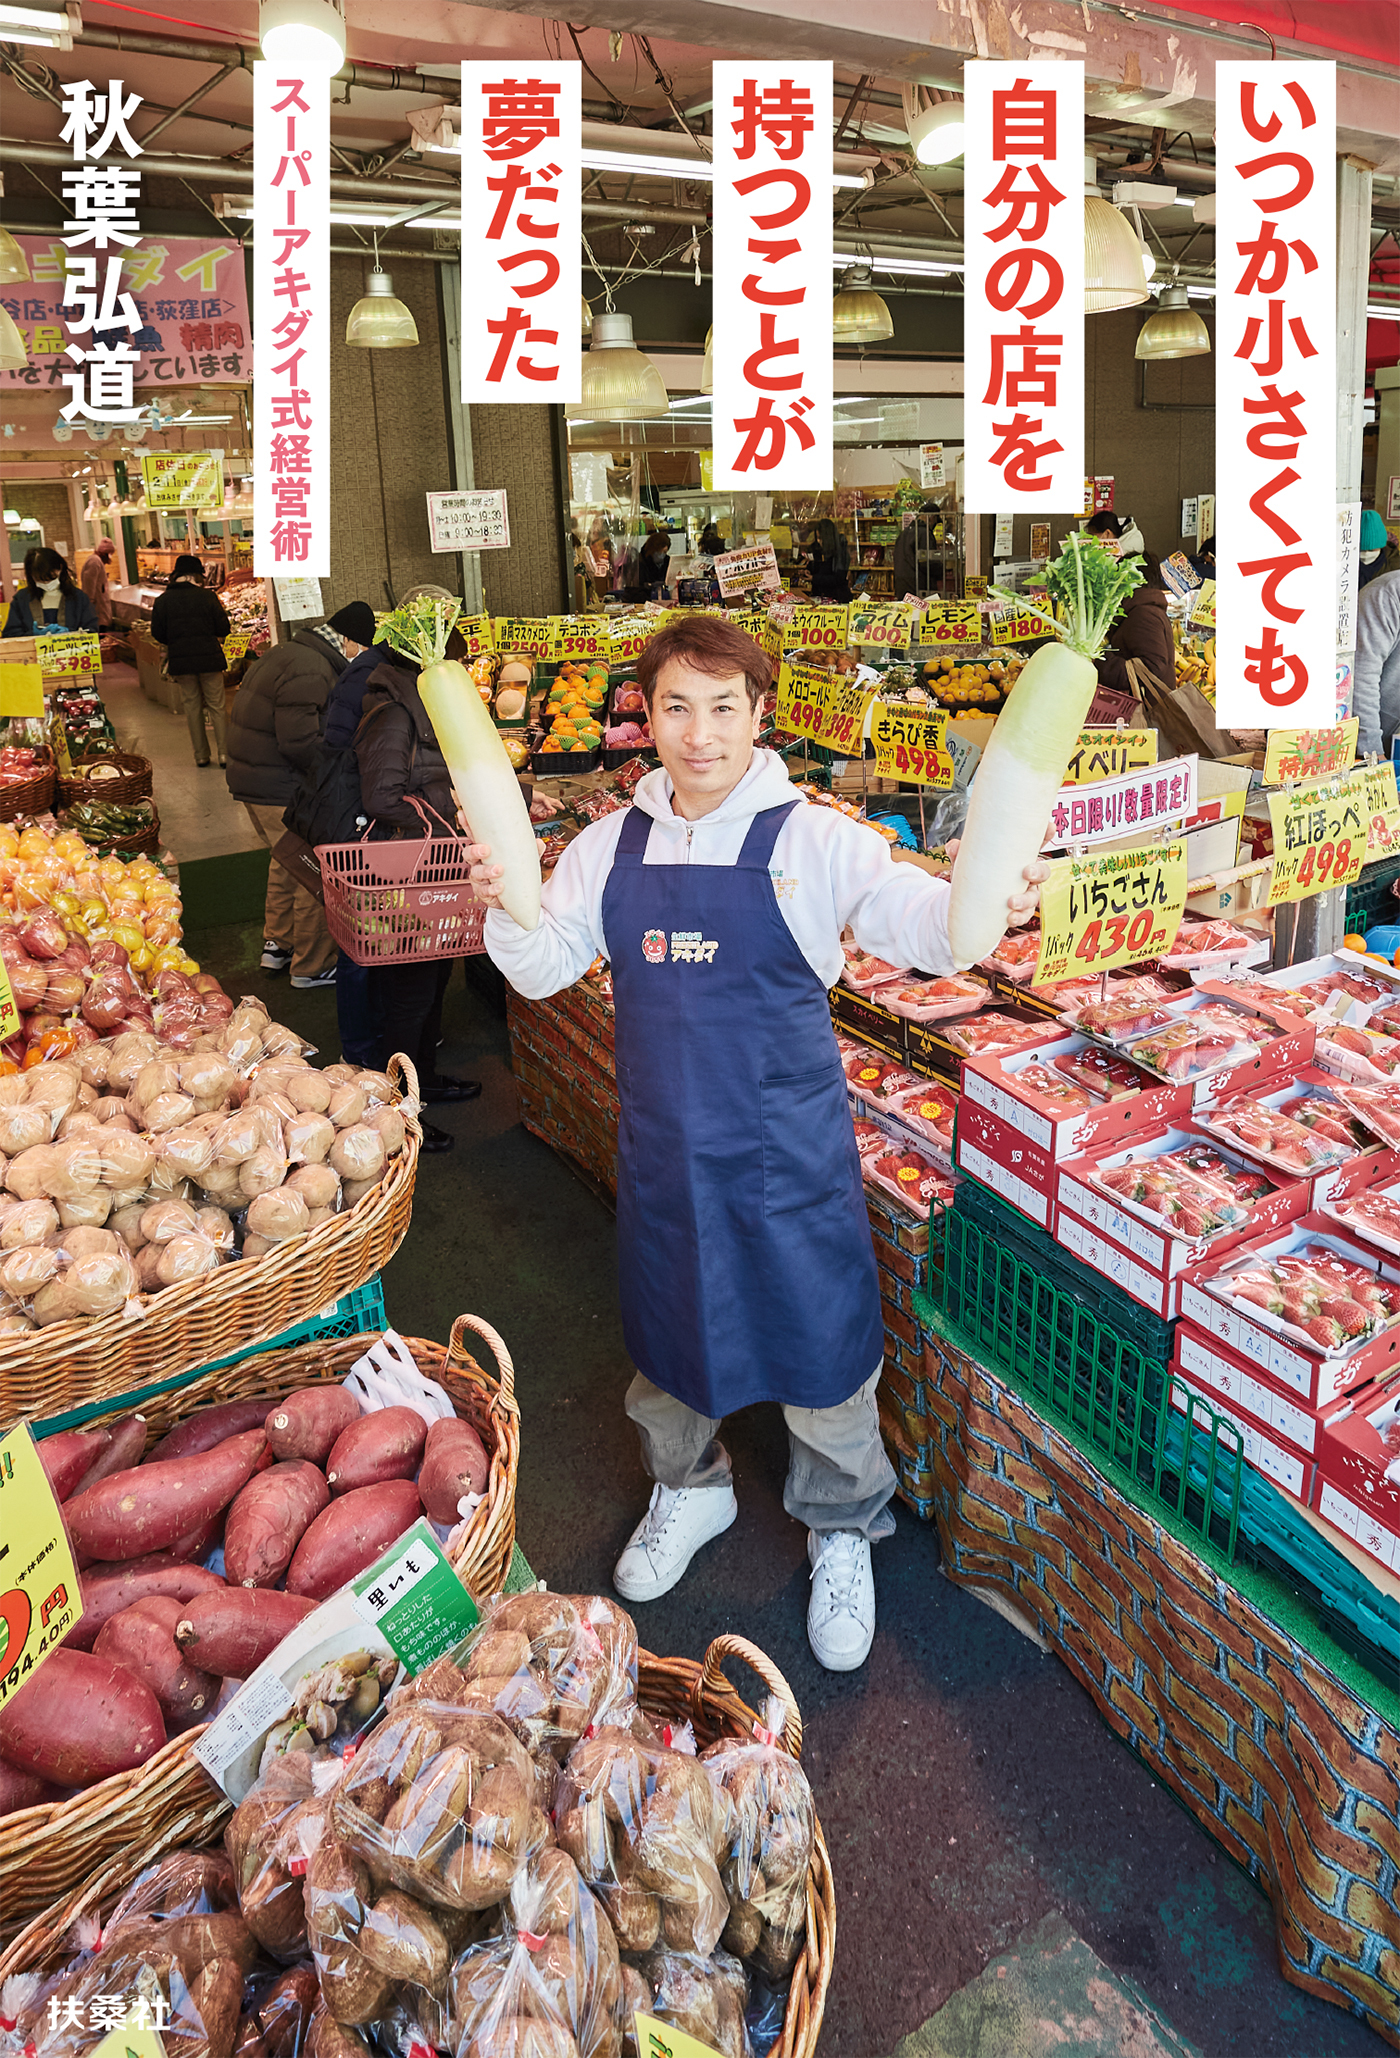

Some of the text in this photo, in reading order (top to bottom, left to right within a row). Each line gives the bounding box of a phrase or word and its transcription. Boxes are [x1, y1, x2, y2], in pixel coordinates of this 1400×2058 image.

[179, 321, 244, 352] 精肉
[792, 614, 842, 628] キウイフルーツ
[861, 609, 908, 628] ライム
[926, 609, 975, 624] レモン
[501, 625, 550, 641] 静岡マスクメロン
[559, 623, 601, 637] デコポン
[801, 628, 843, 645] 100円
[865, 625, 907, 644] 100円
[936, 623, 979, 641] 68円
[1008, 617, 1052, 639] 180円
[465, 638, 488, 653] 8円
[563, 637, 605, 653] 398円
[788, 679, 830, 708] メロゴールド
[790, 701, 823, 733] 498
[878, 719, 939, 750] きらぴ香
[1296, 726, 1345, 752] 本日の
[896, 745, 951, 779] 498円
[1052, 772, 1189, 838] 本日限り!数量限定!
[1284, 802, 1360, 851] 紅ほっぺ
[1296, 838, 1360, 888] 498円
[1069, 868, 1168, 924] いちごさん
[1075, 909, 1167, 963] 430円
[851, 1004, 885, 1026] スカイベリー
[1144, 1088, 1176, 1109] いちごさん
[969, 1114, 1000, 1142] いちごさん
[1218, 1320, 1231, 1337] 秀
[1218, 1373, 1232, 1391] 秀
[1322, 1496, 1356, 1527] いちごさん
[1366, 1531, 1383, 1552] 秀
[366, 1558, 421, 1611] 里いも
[386, 1593, 433, 1633] ねっとりした
